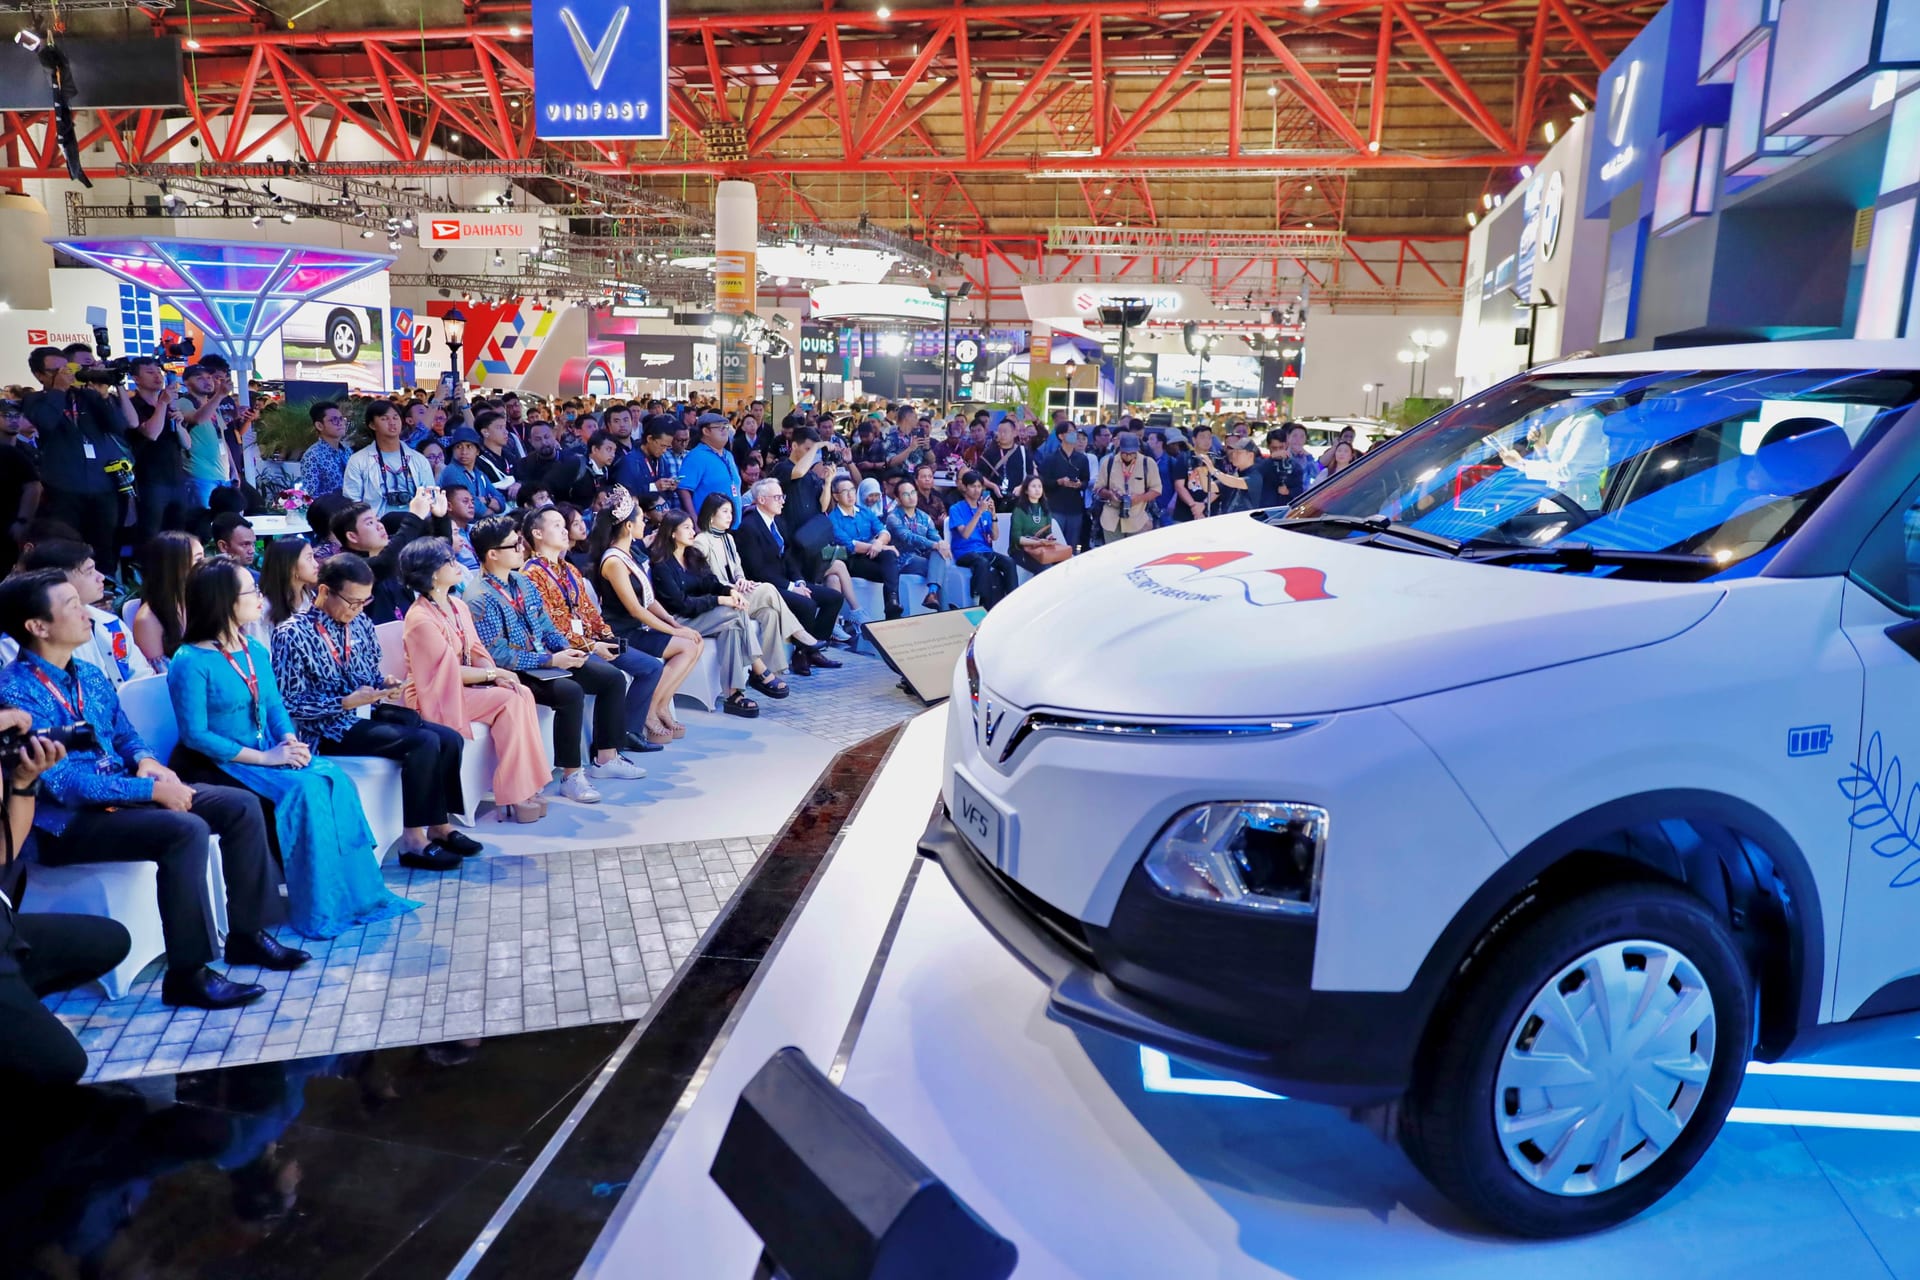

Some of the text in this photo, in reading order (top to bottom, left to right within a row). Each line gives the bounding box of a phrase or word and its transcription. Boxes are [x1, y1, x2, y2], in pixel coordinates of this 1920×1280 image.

[547, 102, 648, 120] VINFAST
[463, 224, 523, 236] DAIHATSU
[50, 333, 92, 343] DAIHATSU
[963, 796, 989, 837] VF5
